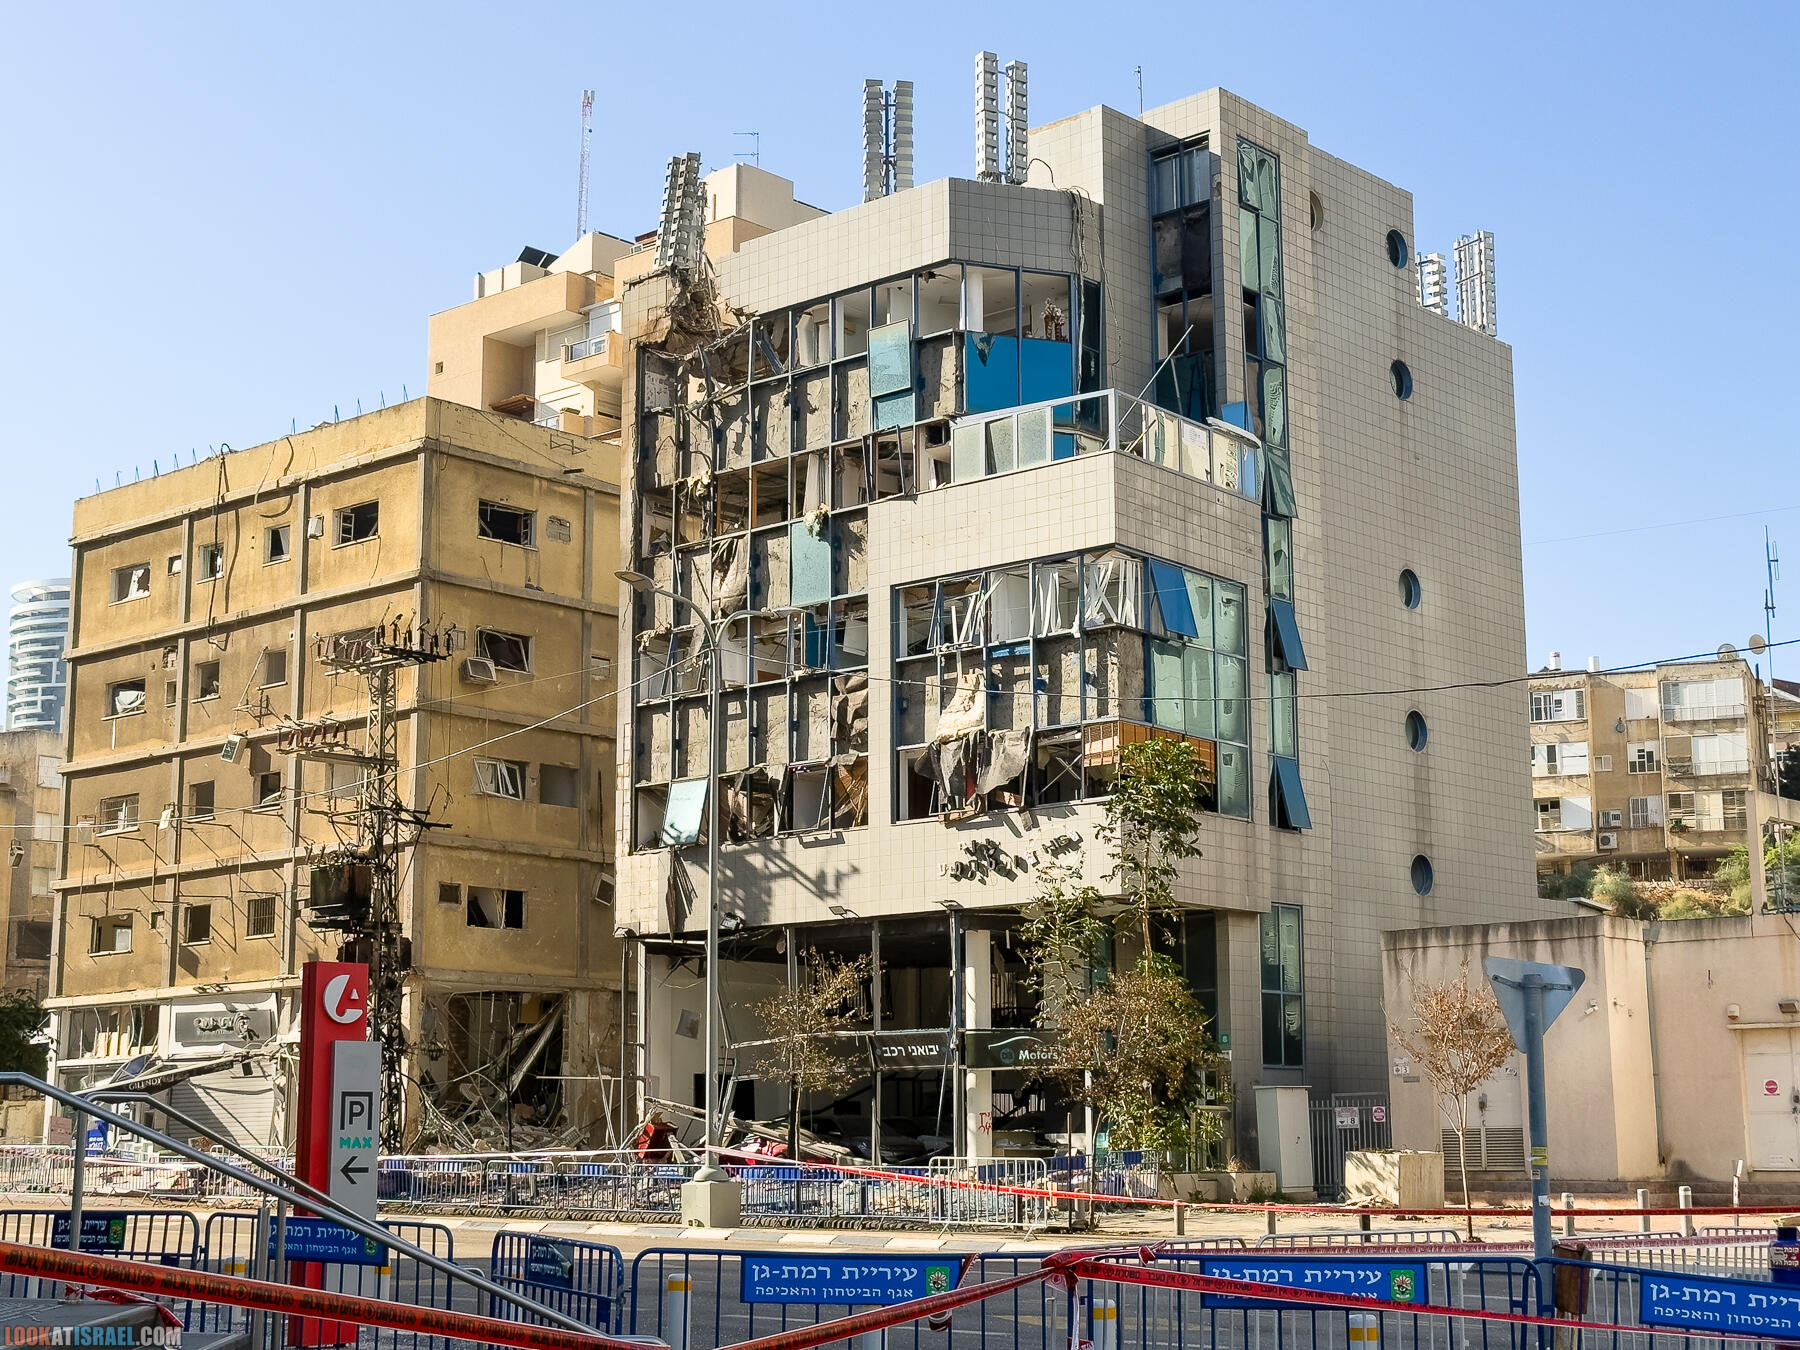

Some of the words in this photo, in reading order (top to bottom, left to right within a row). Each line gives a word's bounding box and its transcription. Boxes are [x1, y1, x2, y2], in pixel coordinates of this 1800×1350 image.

[882, 1046, 906, 1057] רכב
[908, 1044, 940, 1056] יבואני
[1018, 1049, 1059, 1060] Motors
[339, 1136, 373, 1149] MAX
[316, 1226, 360, 1241] עיריית
[305, 1243, 339, 1253] הביטחון
[341, 1246, 357, 1255] אגף
[752, 1264, 832, 1282] רמת-גן
[841, 1267, 918, 1282] עיריית
[1304, 1268, 1382, 1285] עיריית
[755, 1286, 816, 1297] והאכיפה
[822, 1287, 881, 1299] הביטחון
[886, 1288, 913, 1299] אגף
[1649, 1283, 1736, 1305] רמת-גן
[1748, 1292, 1800, 1312] ריית
[1653, 1305, 1720, 1321] והאכיפה
[1727, 1312, 1792, 1328] הביטחון
